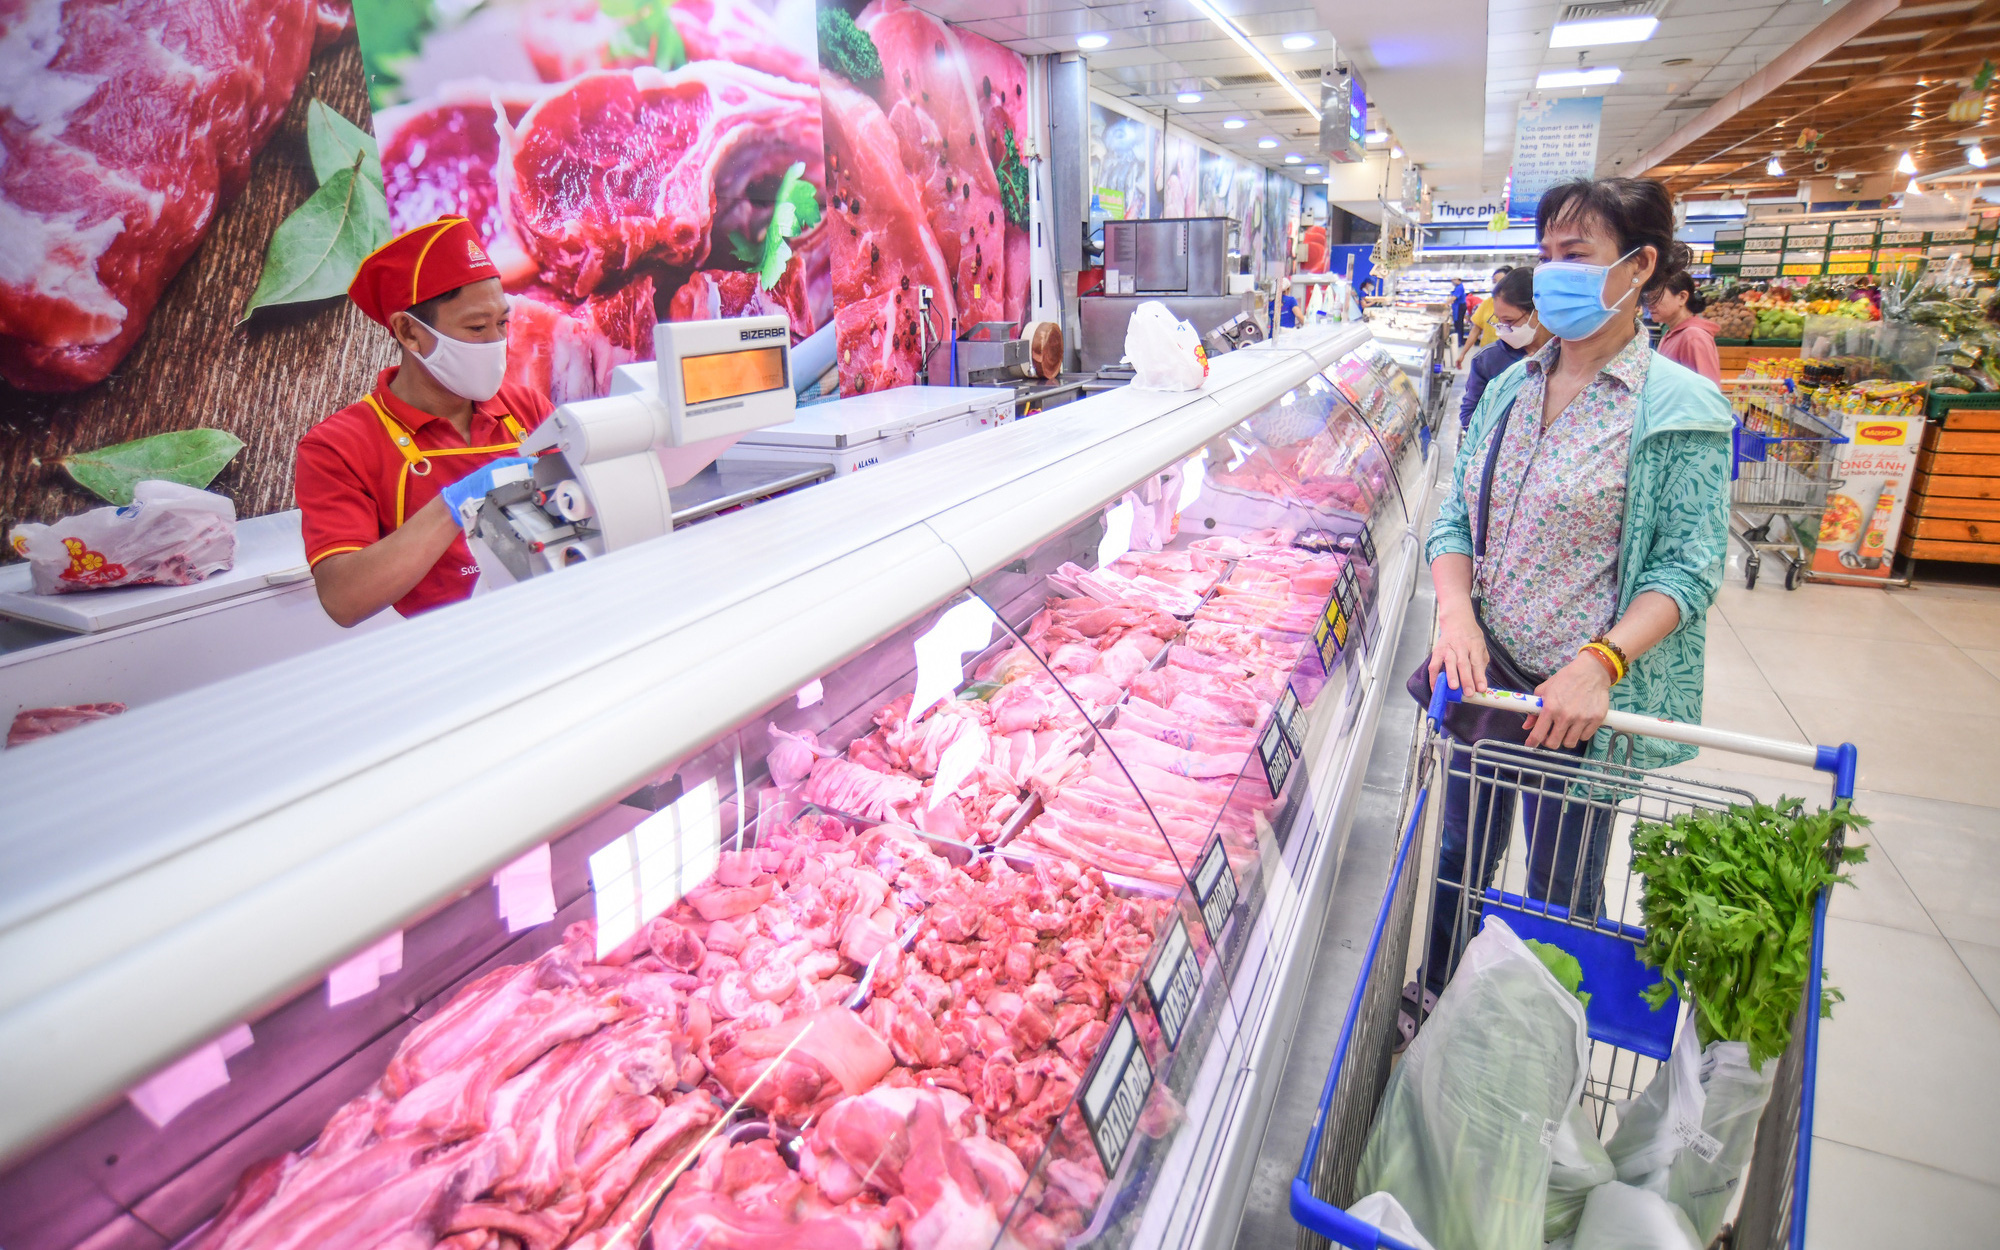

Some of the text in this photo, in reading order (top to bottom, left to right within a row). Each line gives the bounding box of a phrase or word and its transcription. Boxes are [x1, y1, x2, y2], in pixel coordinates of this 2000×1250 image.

[1438, 204, 1475, 218] Thực
[740, 327, 786, 341] BIZERBA
[857, 456, 879, 469] ALASKA
